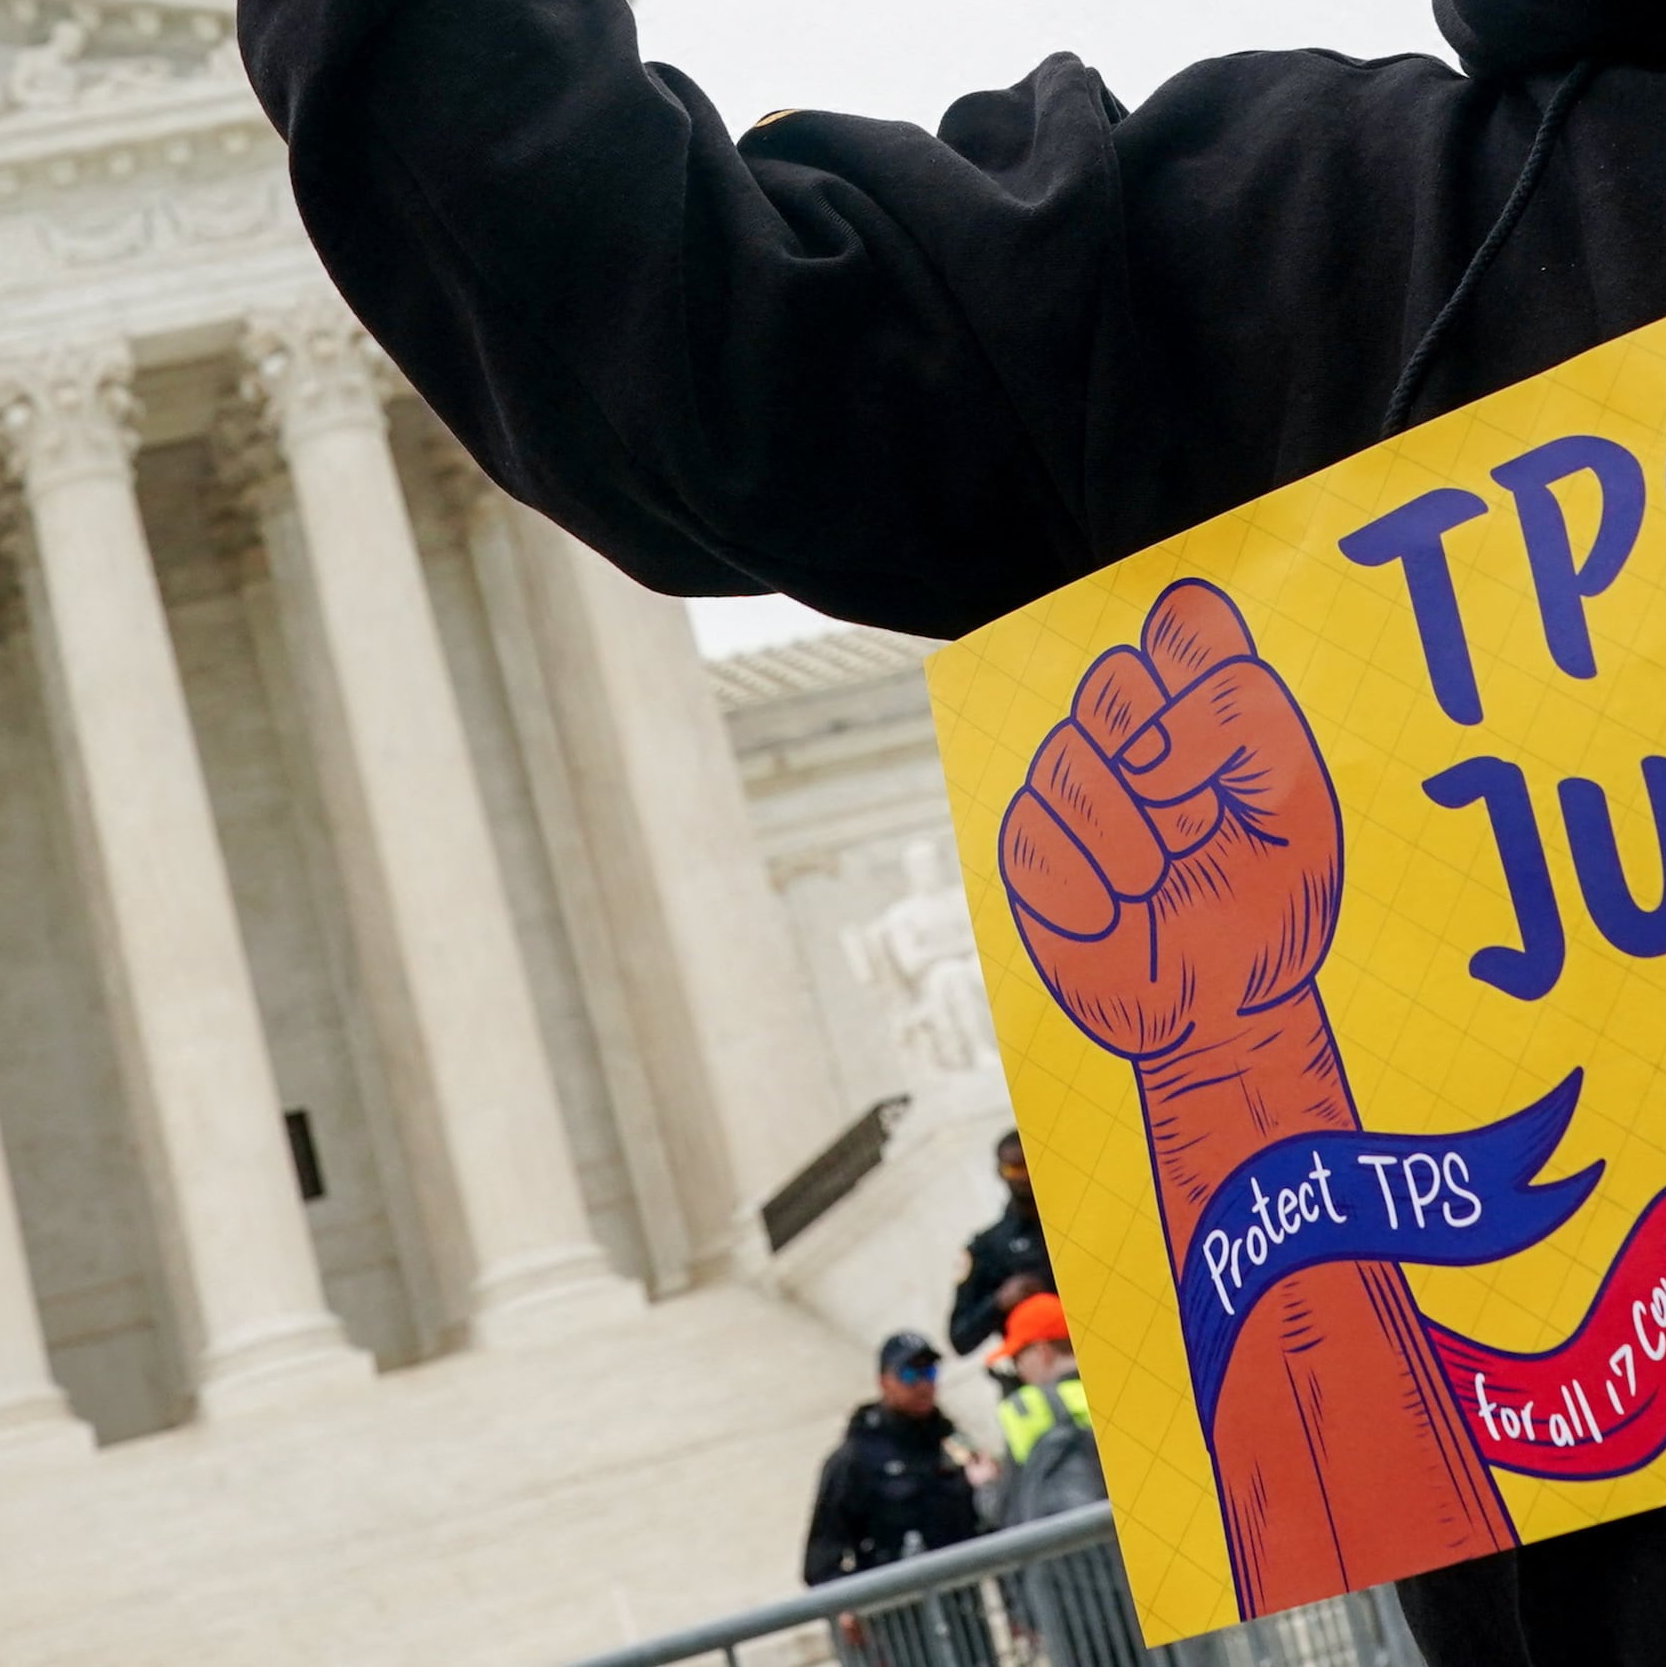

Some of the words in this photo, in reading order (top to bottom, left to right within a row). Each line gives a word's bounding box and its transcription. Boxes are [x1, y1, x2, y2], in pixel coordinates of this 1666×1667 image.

[1203, 1150, 1347, 1315] Protect
[1357, 1152, 1482, 1229] TPS
[1475, 1372, 1535, 1441] for
[1549, 1379, 1603, 1447] all
[1606, 1344, 1636, 1415] 17
